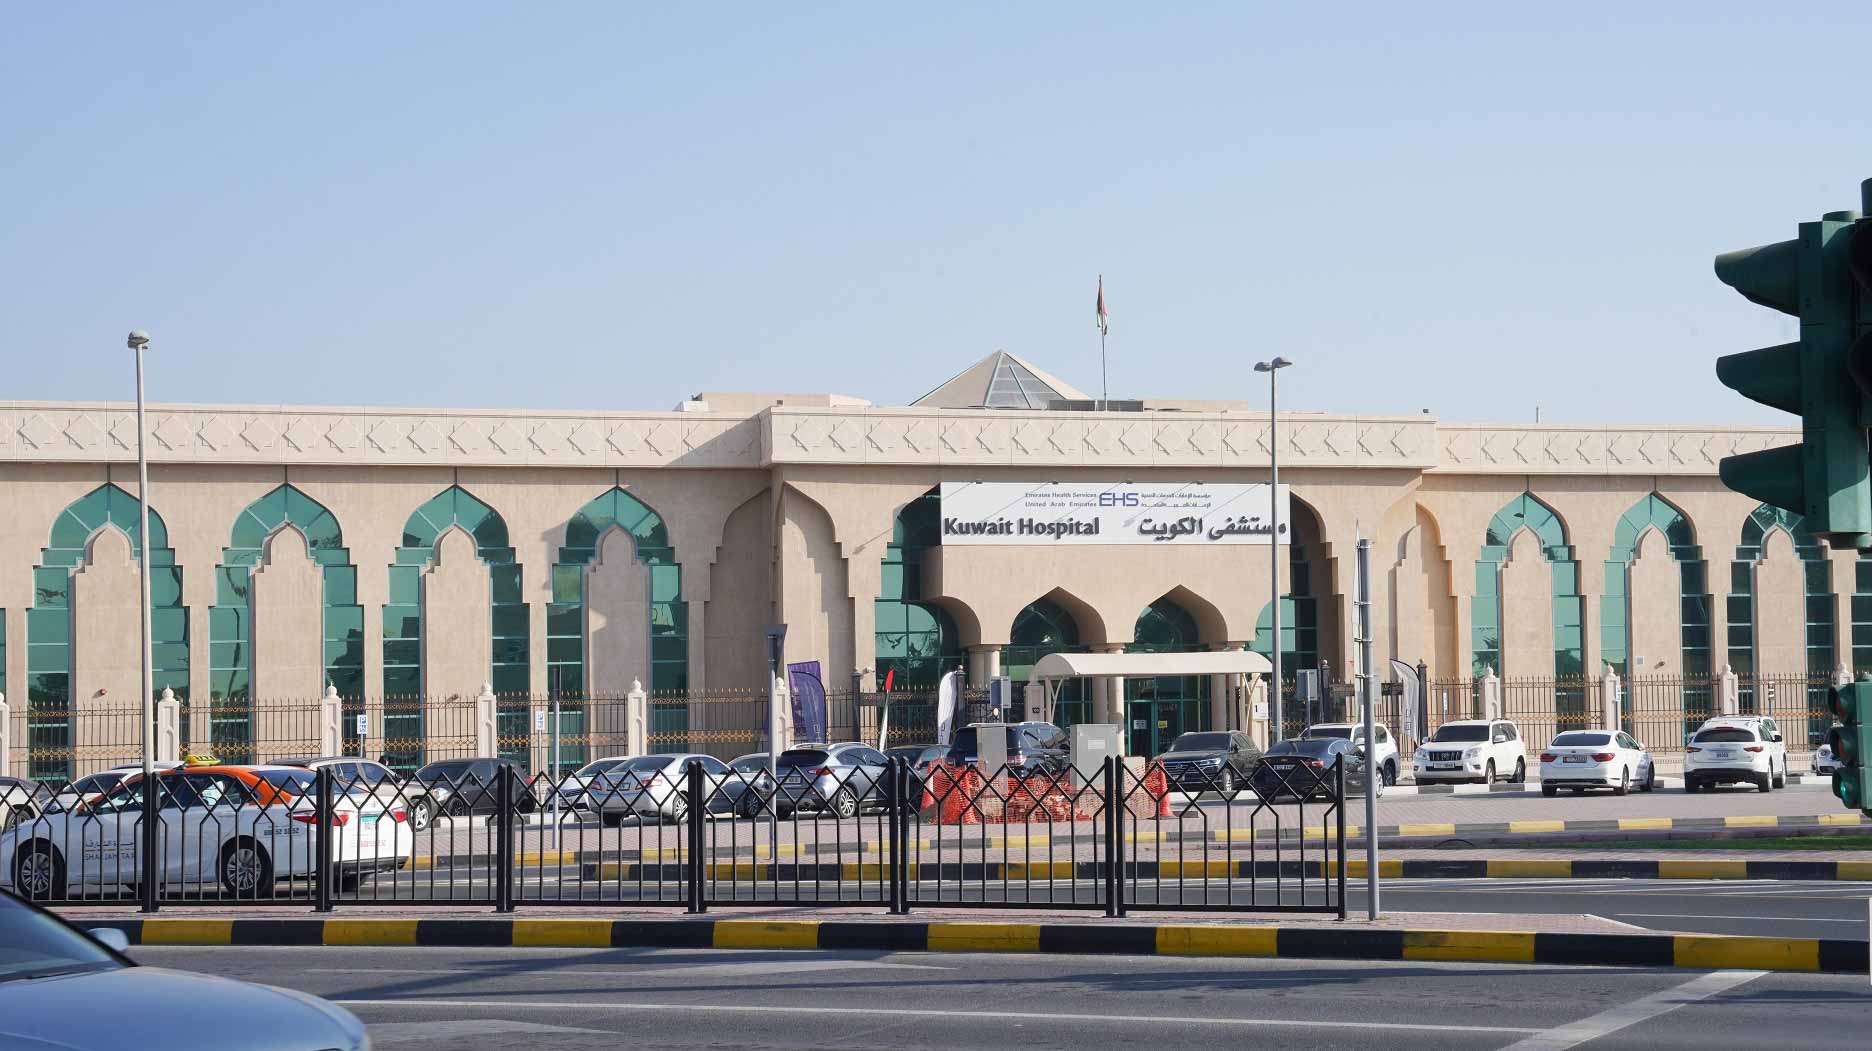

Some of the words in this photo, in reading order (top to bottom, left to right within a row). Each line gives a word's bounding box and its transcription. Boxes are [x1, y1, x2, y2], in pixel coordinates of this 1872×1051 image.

[1099, 492, 1139, 507] EHS
[944, 517, 1013, 536] Kuwait
[1018, 517, 1100, 540] Hospital
[1139, 516, 1203, 541] الكويت
[1208, 515, 1287, 541] مستشفى
